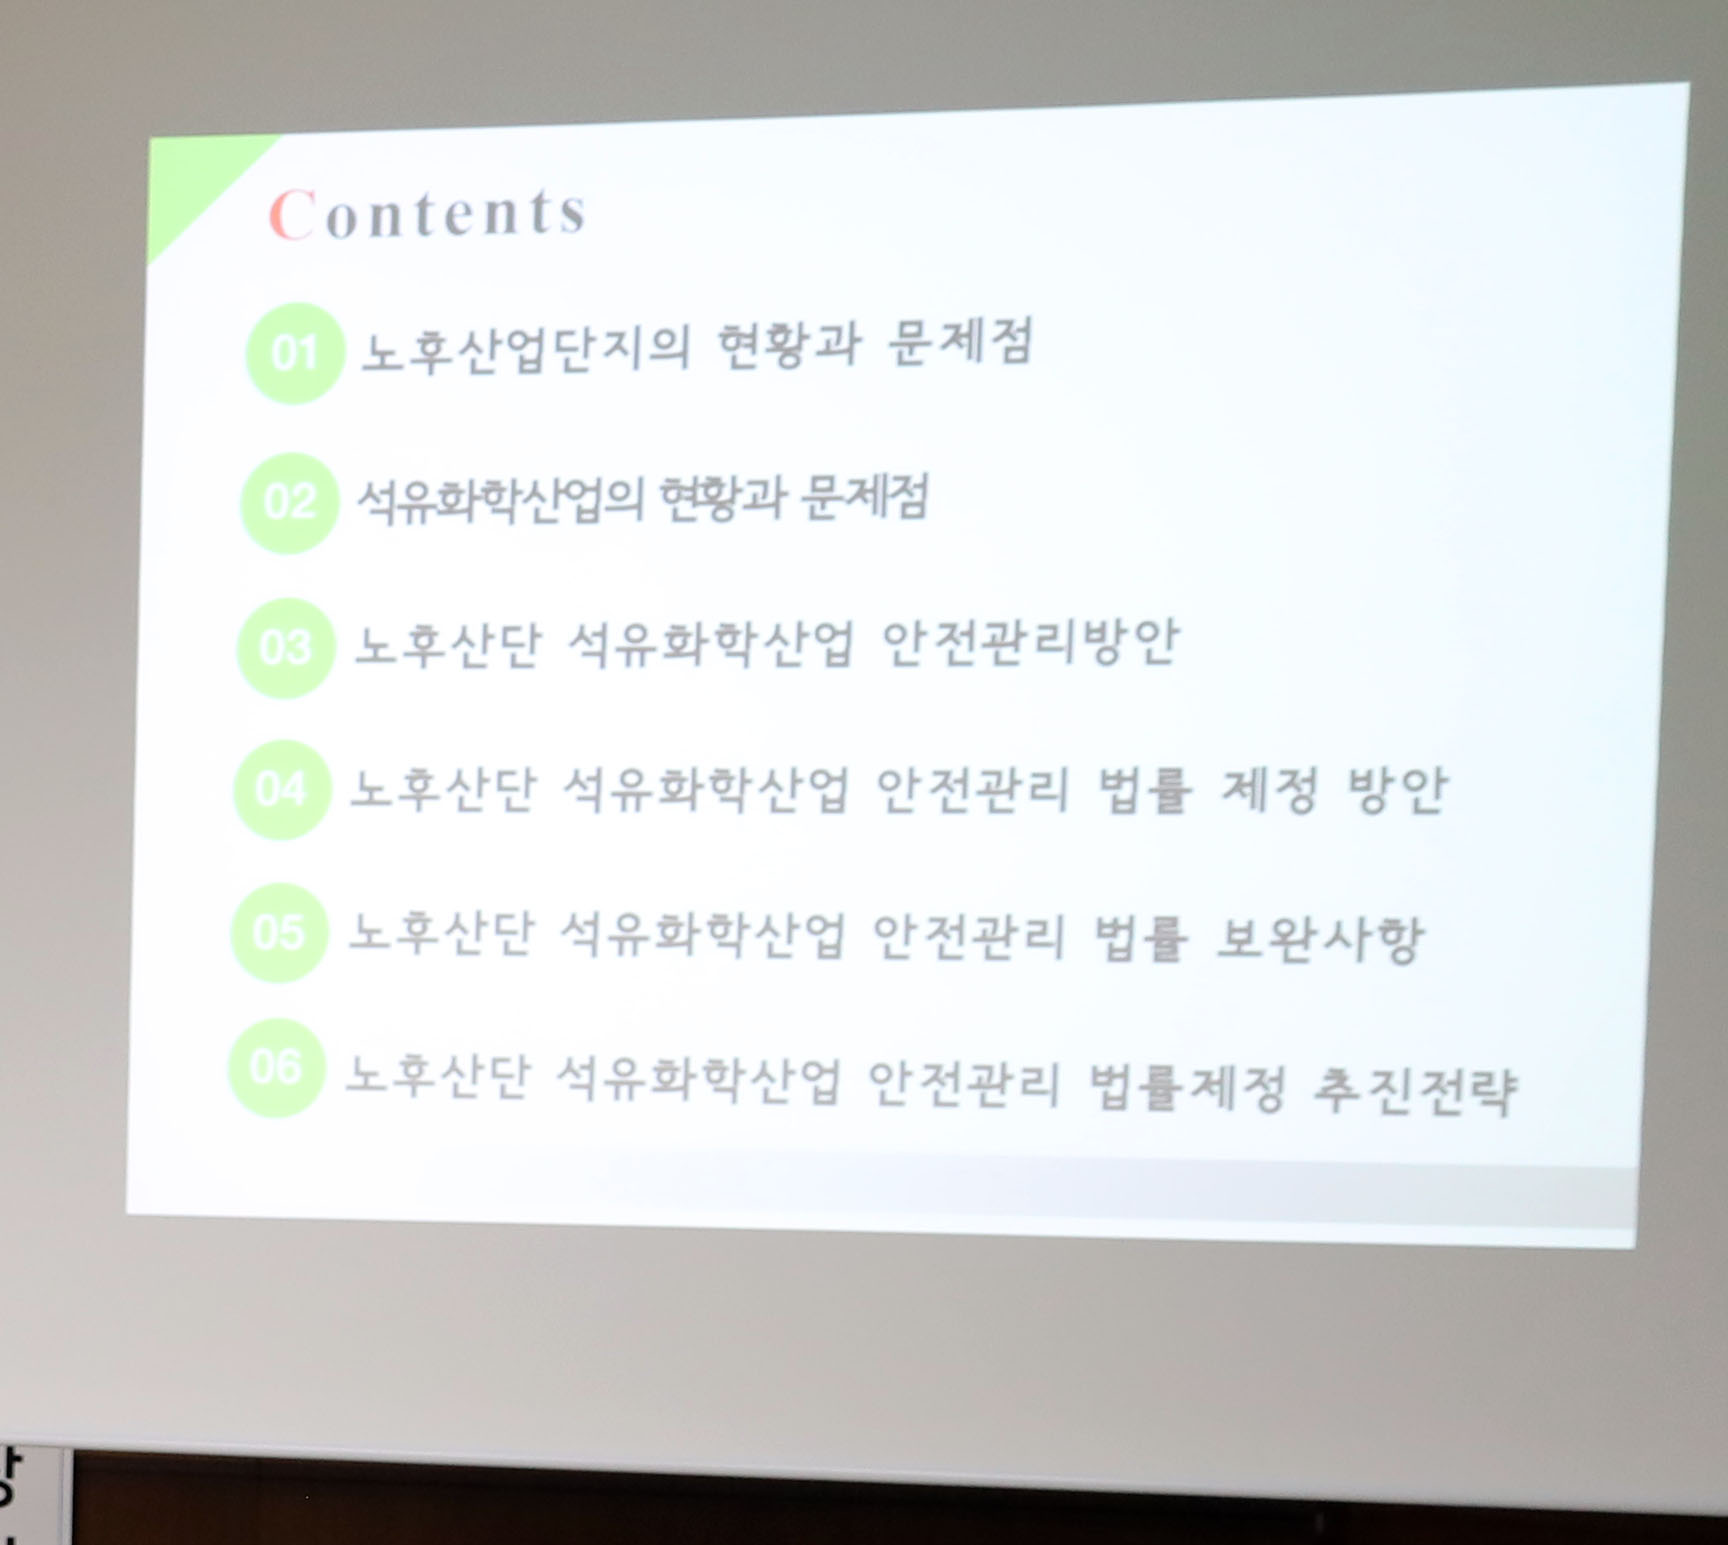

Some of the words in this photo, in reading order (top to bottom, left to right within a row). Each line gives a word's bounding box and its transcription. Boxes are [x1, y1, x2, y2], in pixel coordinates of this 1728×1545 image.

[267, 188, 585, 241] Contents
[270, 334, 320, 372] 01
[360, 322, 692, 377] 노후산업단지의
[717, 318, 865, 372] 현황과
[888, 314, 1033, 367] 문제점
[264, 484, 318, 521] 02
[356, 474, 646, 529] 석유화학산업의
[658, 472, 791, 525] 현황과
[799, 470, 931, 523] 문제점
[260, 628, 313, 666] 03
[354, 620, 544, 671] 노후산단
[568, 618, 855, 671] 석유화학산업
[882, 615, 1183, 670] 안전관리방안
[255, 770, 308, 808] 04
[349, 764, 539, 815] 노후산단
[562, 764, 850, 816] 석유화학산업
[876, 764, 1070, 816] 안전관리
[1099, 764, 1196, 818] 법률
[1220, 765, 1320, 818] 제정
[1348, 764, 1453, 818] 방안
[252, 914, 306, 951] 05
[348, 908, 537, 959] 노후산단
[559, 909, 847, 963] 석유화학산업
[873, 911, 1066, 964] 안전관리
[1095, 913, 1192, 966] 법률
[1215, 914, 1429, 968] 보완사항
[249, 1049, 303, 1087] 06
[344, 1051, 533, 1102] 노후산단
[556, 1053, 842, 1108] 석유화학산업
[868, 1057, 1061, 1111] 안전관리
[1090, 1062, 1287, 1117] 법률제정
[1312, 1065, 1521, 1121] 추진전략
